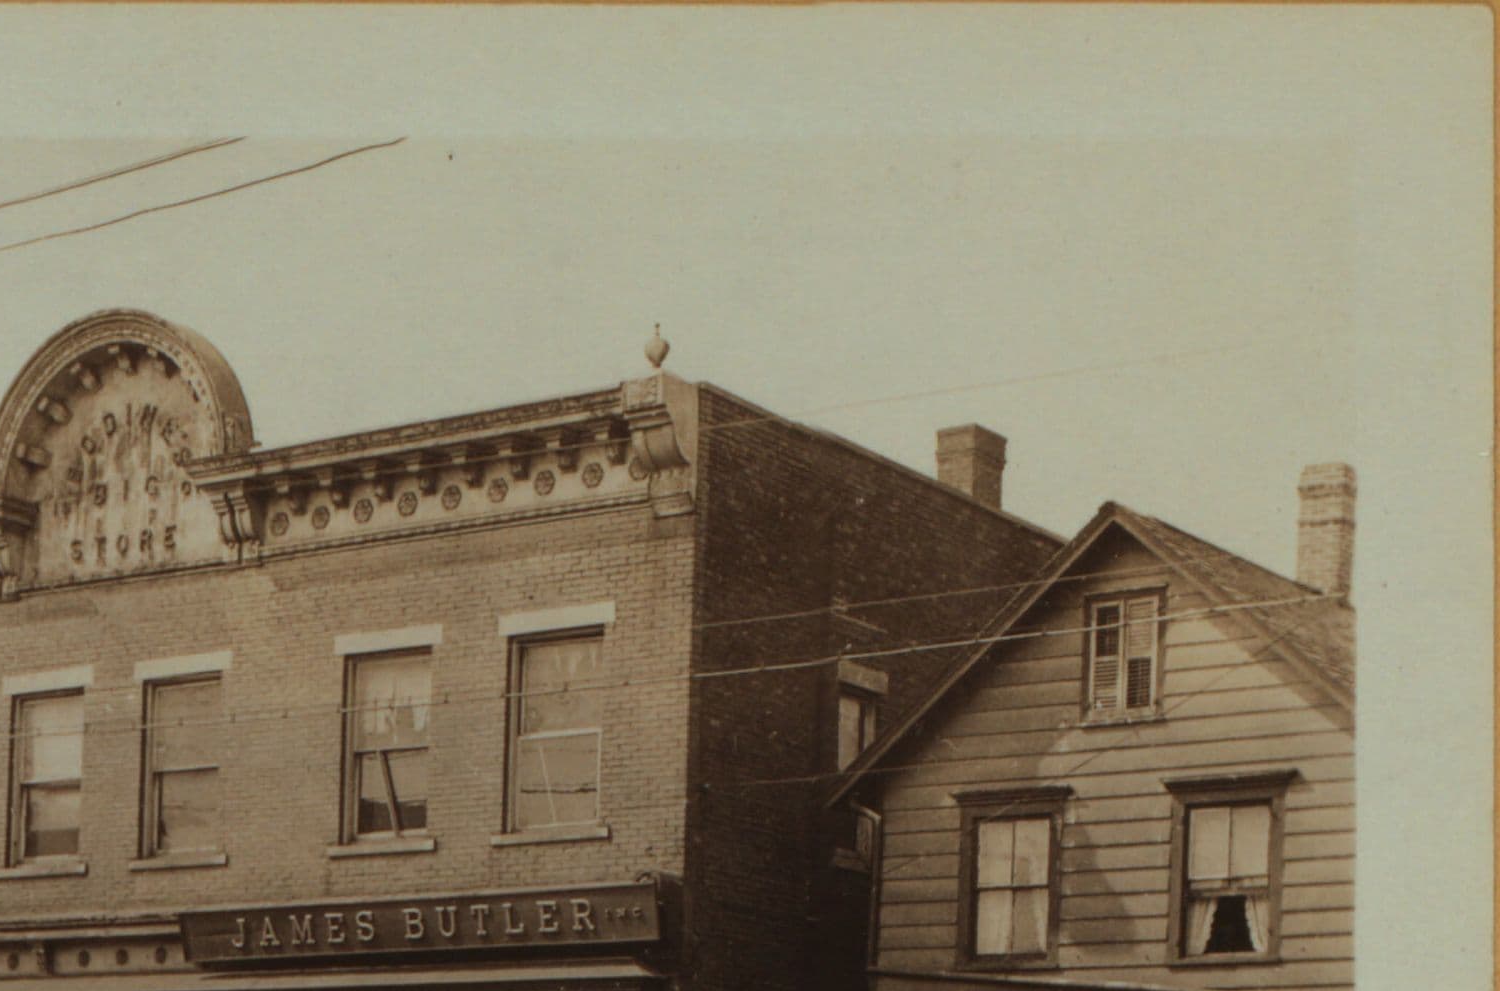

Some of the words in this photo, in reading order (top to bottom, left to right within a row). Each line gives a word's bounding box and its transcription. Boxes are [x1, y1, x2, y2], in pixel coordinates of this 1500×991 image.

[69, 525, 177, 565] STORE
[231, 909, 376, 949] JAMES
[403, 898, 596, 941] BUTLER
